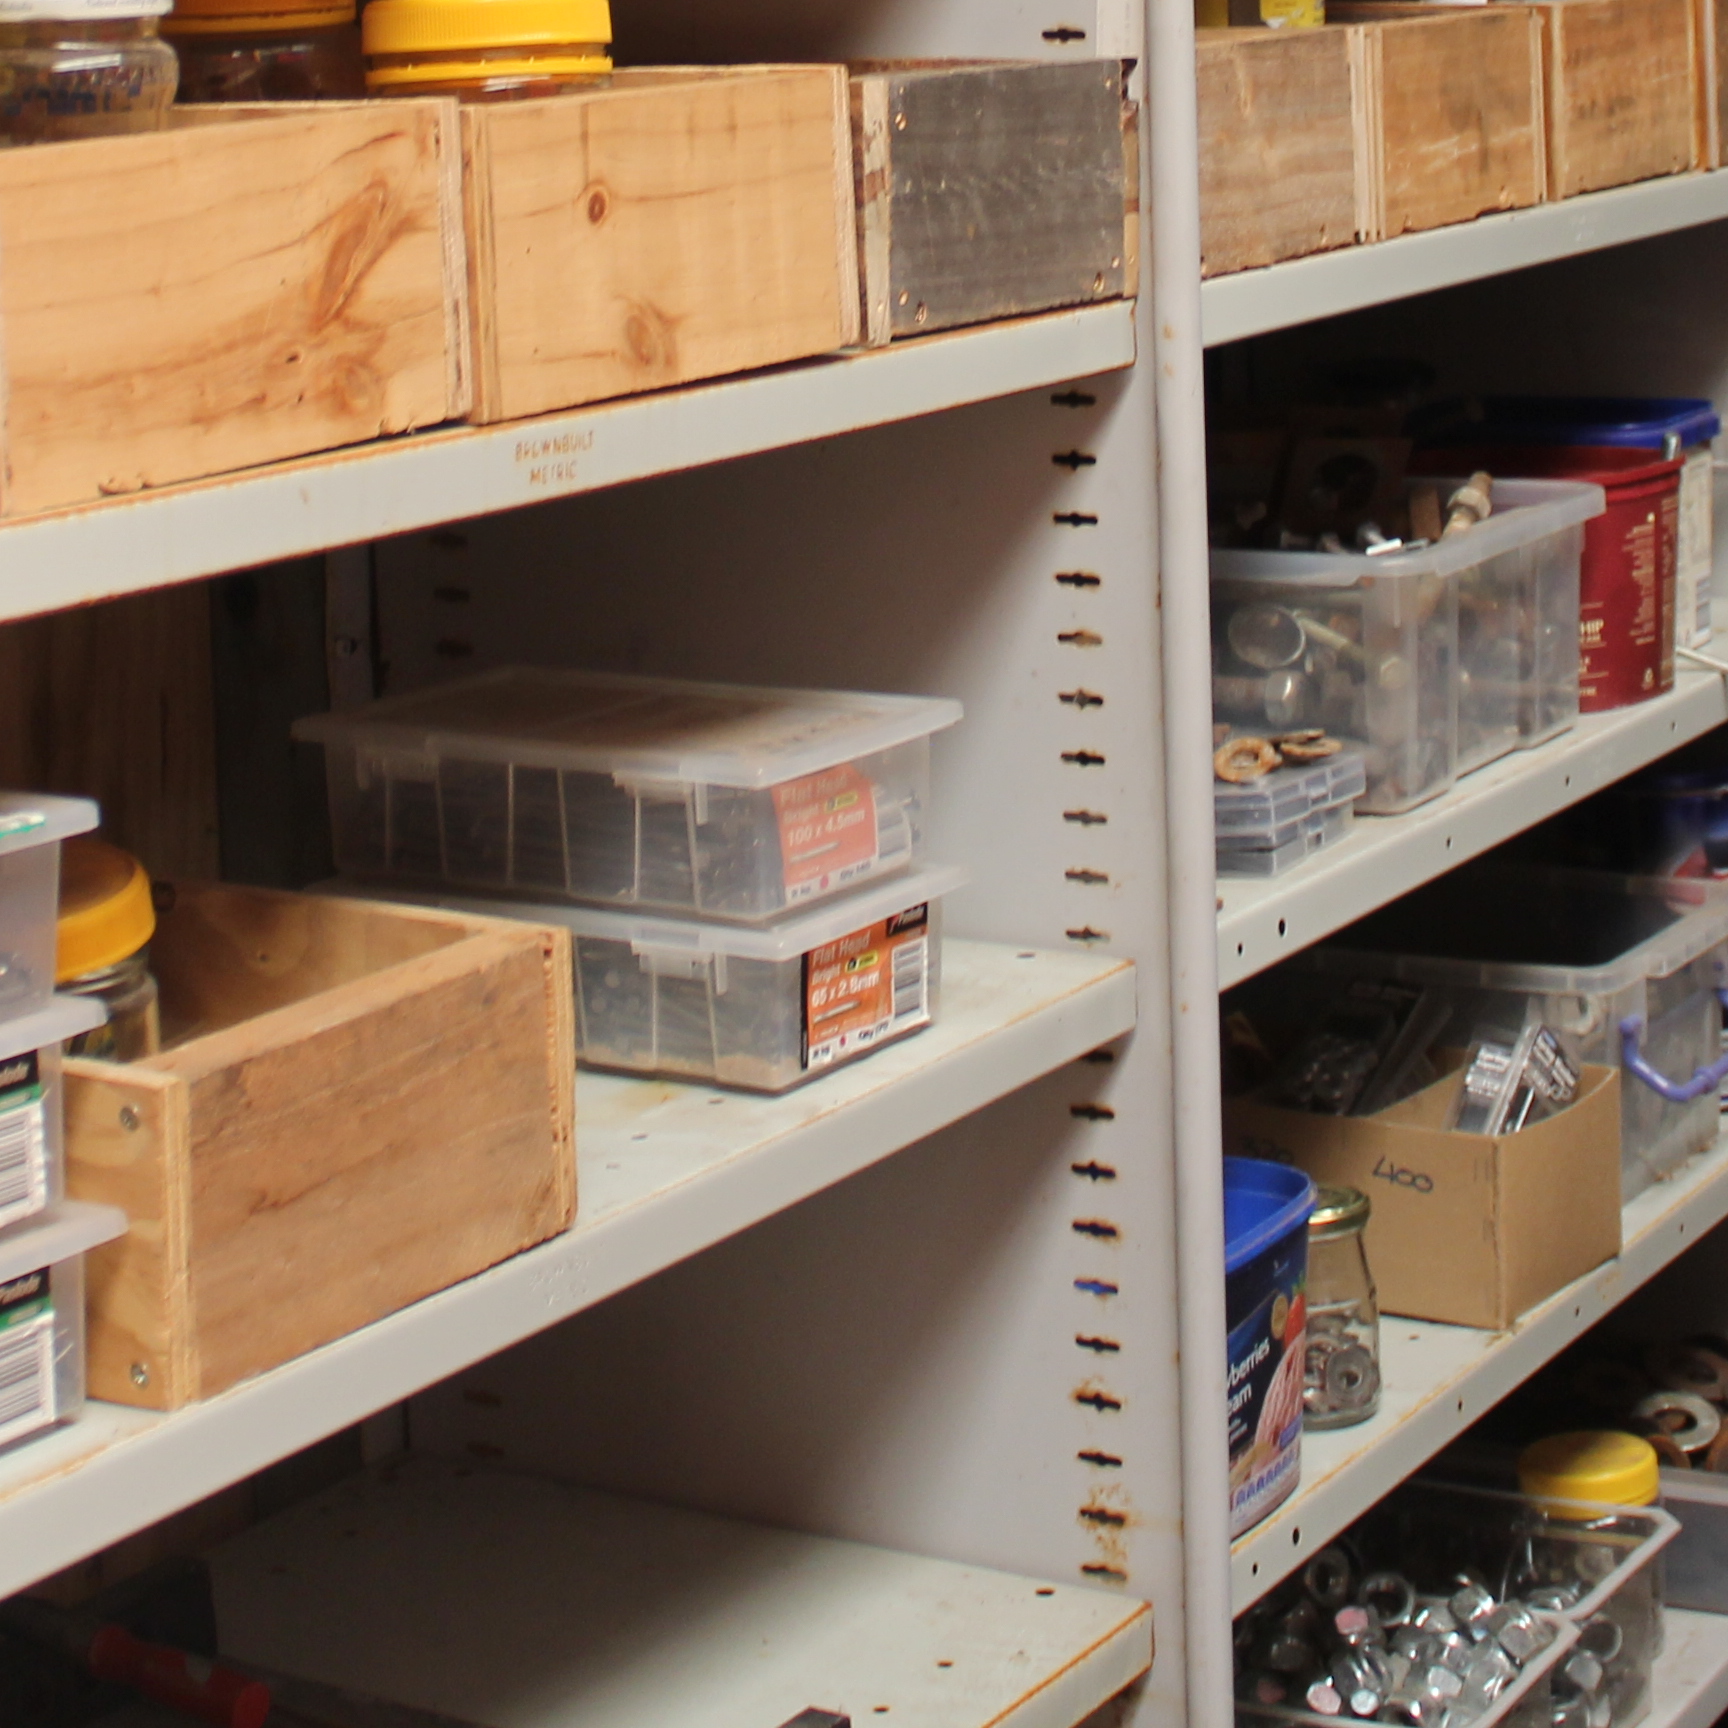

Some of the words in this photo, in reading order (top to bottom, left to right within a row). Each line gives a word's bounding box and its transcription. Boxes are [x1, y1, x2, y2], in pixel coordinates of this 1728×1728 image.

[786, 824, 813, 848] 100
[837, 970, 881, 1000] 2.8mm
[1372, 1154, 1436, 1194] 400
[1227, 1381, 1253, 1418] eam
